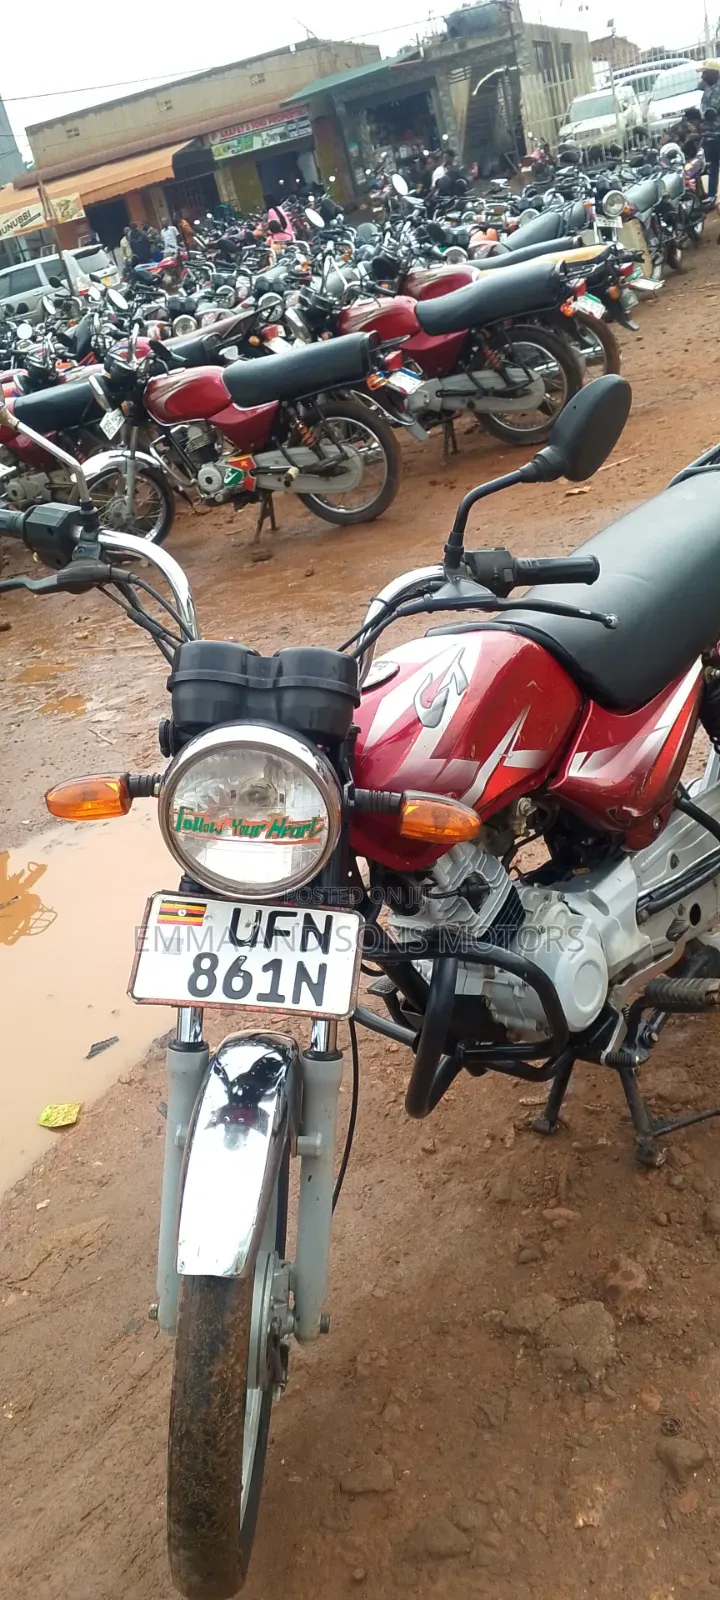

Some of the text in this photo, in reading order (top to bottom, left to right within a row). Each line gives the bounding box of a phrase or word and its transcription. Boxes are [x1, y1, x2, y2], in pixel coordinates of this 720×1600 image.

[0, 210, 31, 236] UNUBBI
[231, 818, 267, 837] Your
[267, 815, 324, 839] Heart
[229, 907, 333, 955] UFN
[188, 952, 327, 1007] 861N
